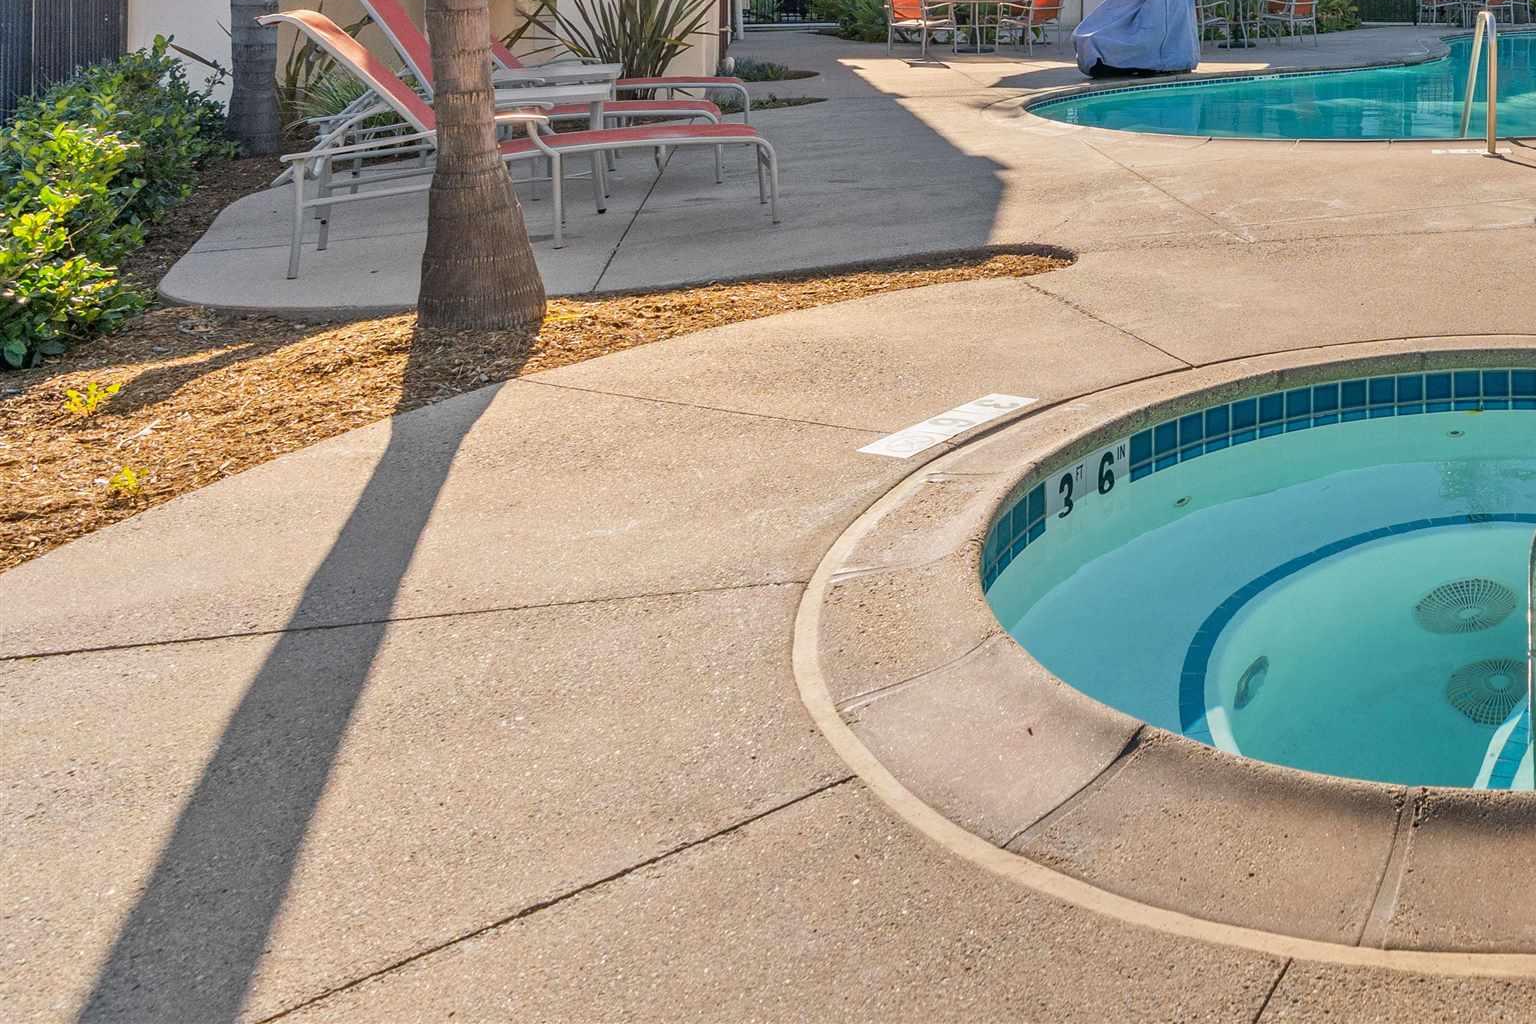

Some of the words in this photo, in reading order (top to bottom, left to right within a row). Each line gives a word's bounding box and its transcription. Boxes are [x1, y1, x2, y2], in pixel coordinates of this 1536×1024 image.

[1058, 472, 1073, 519] 3
[1075, 464, 1084, 481] FT
[1098, 451, 1115, 495] 6
[1117, 443, 1126, 461] IN
